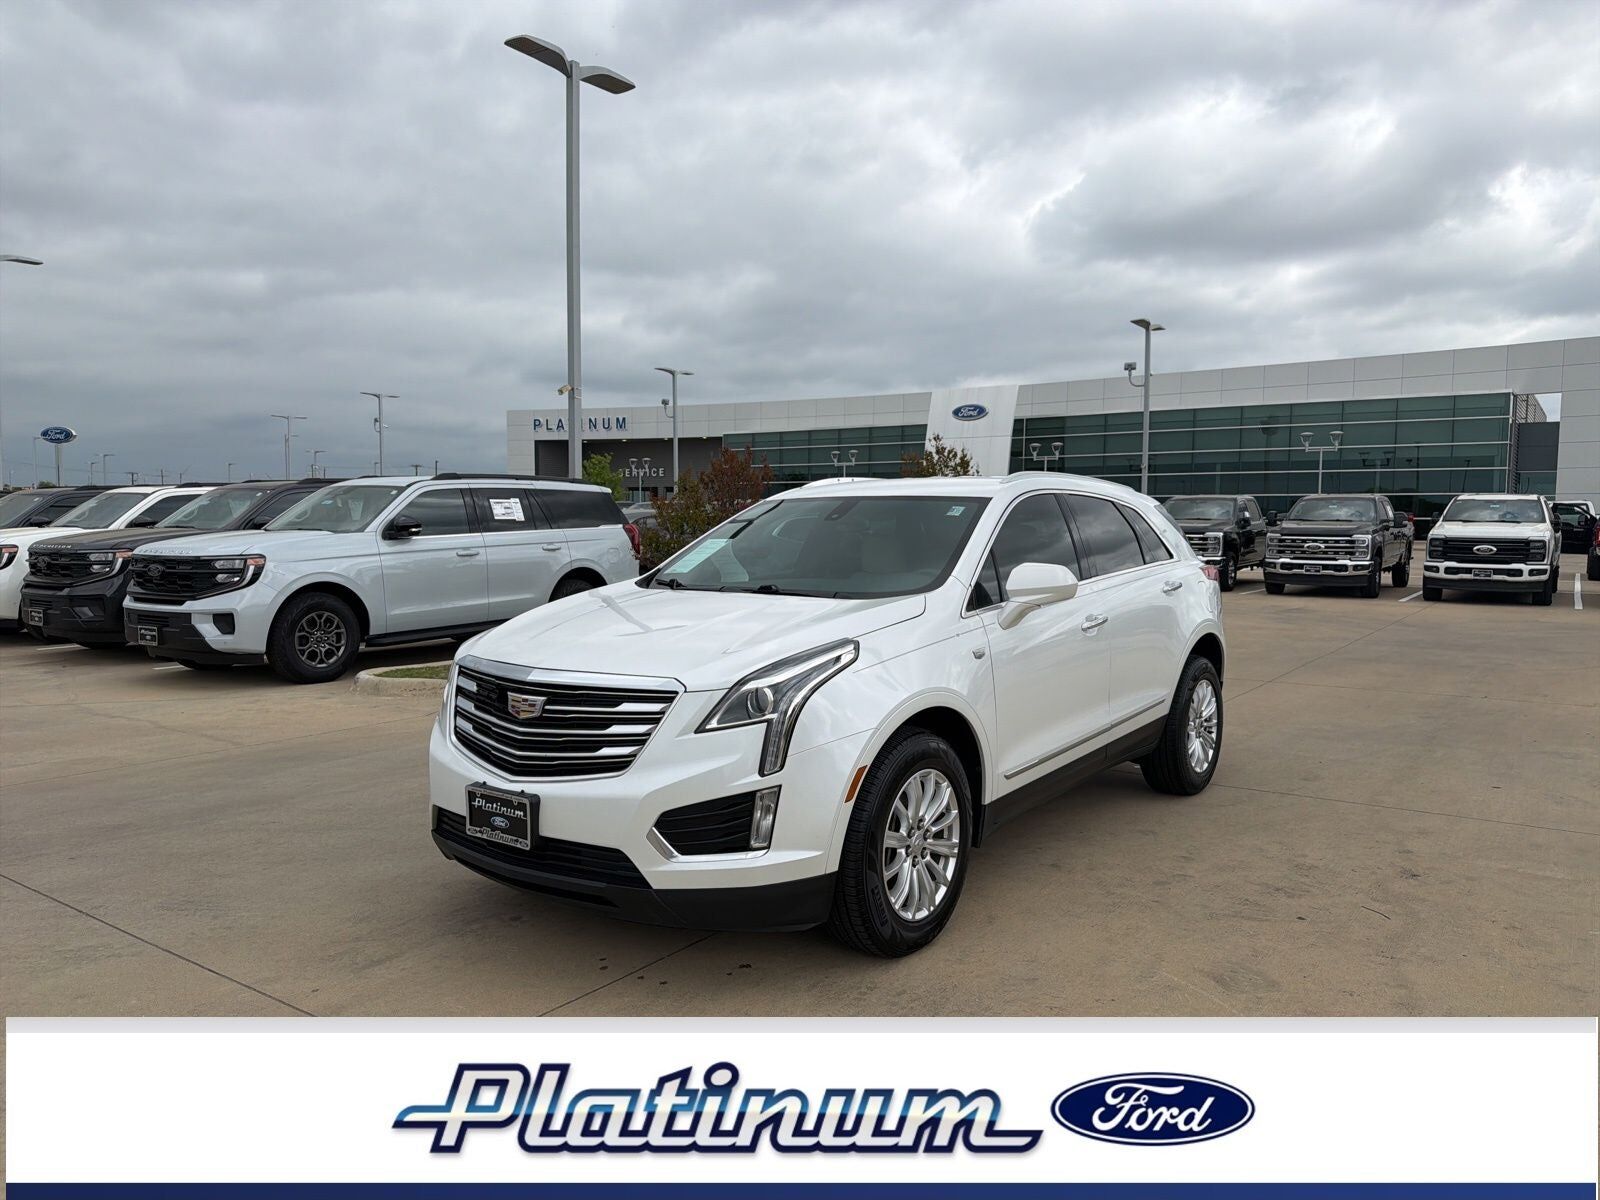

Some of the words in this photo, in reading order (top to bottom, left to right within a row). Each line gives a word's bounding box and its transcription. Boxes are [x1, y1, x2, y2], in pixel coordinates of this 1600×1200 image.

[958, 406, 980, 417] Ford
[533, 416, 626, 431] PLANUM
[46, 429, 66, 440] Ford
[471, 797, 528, 820] Platinum
